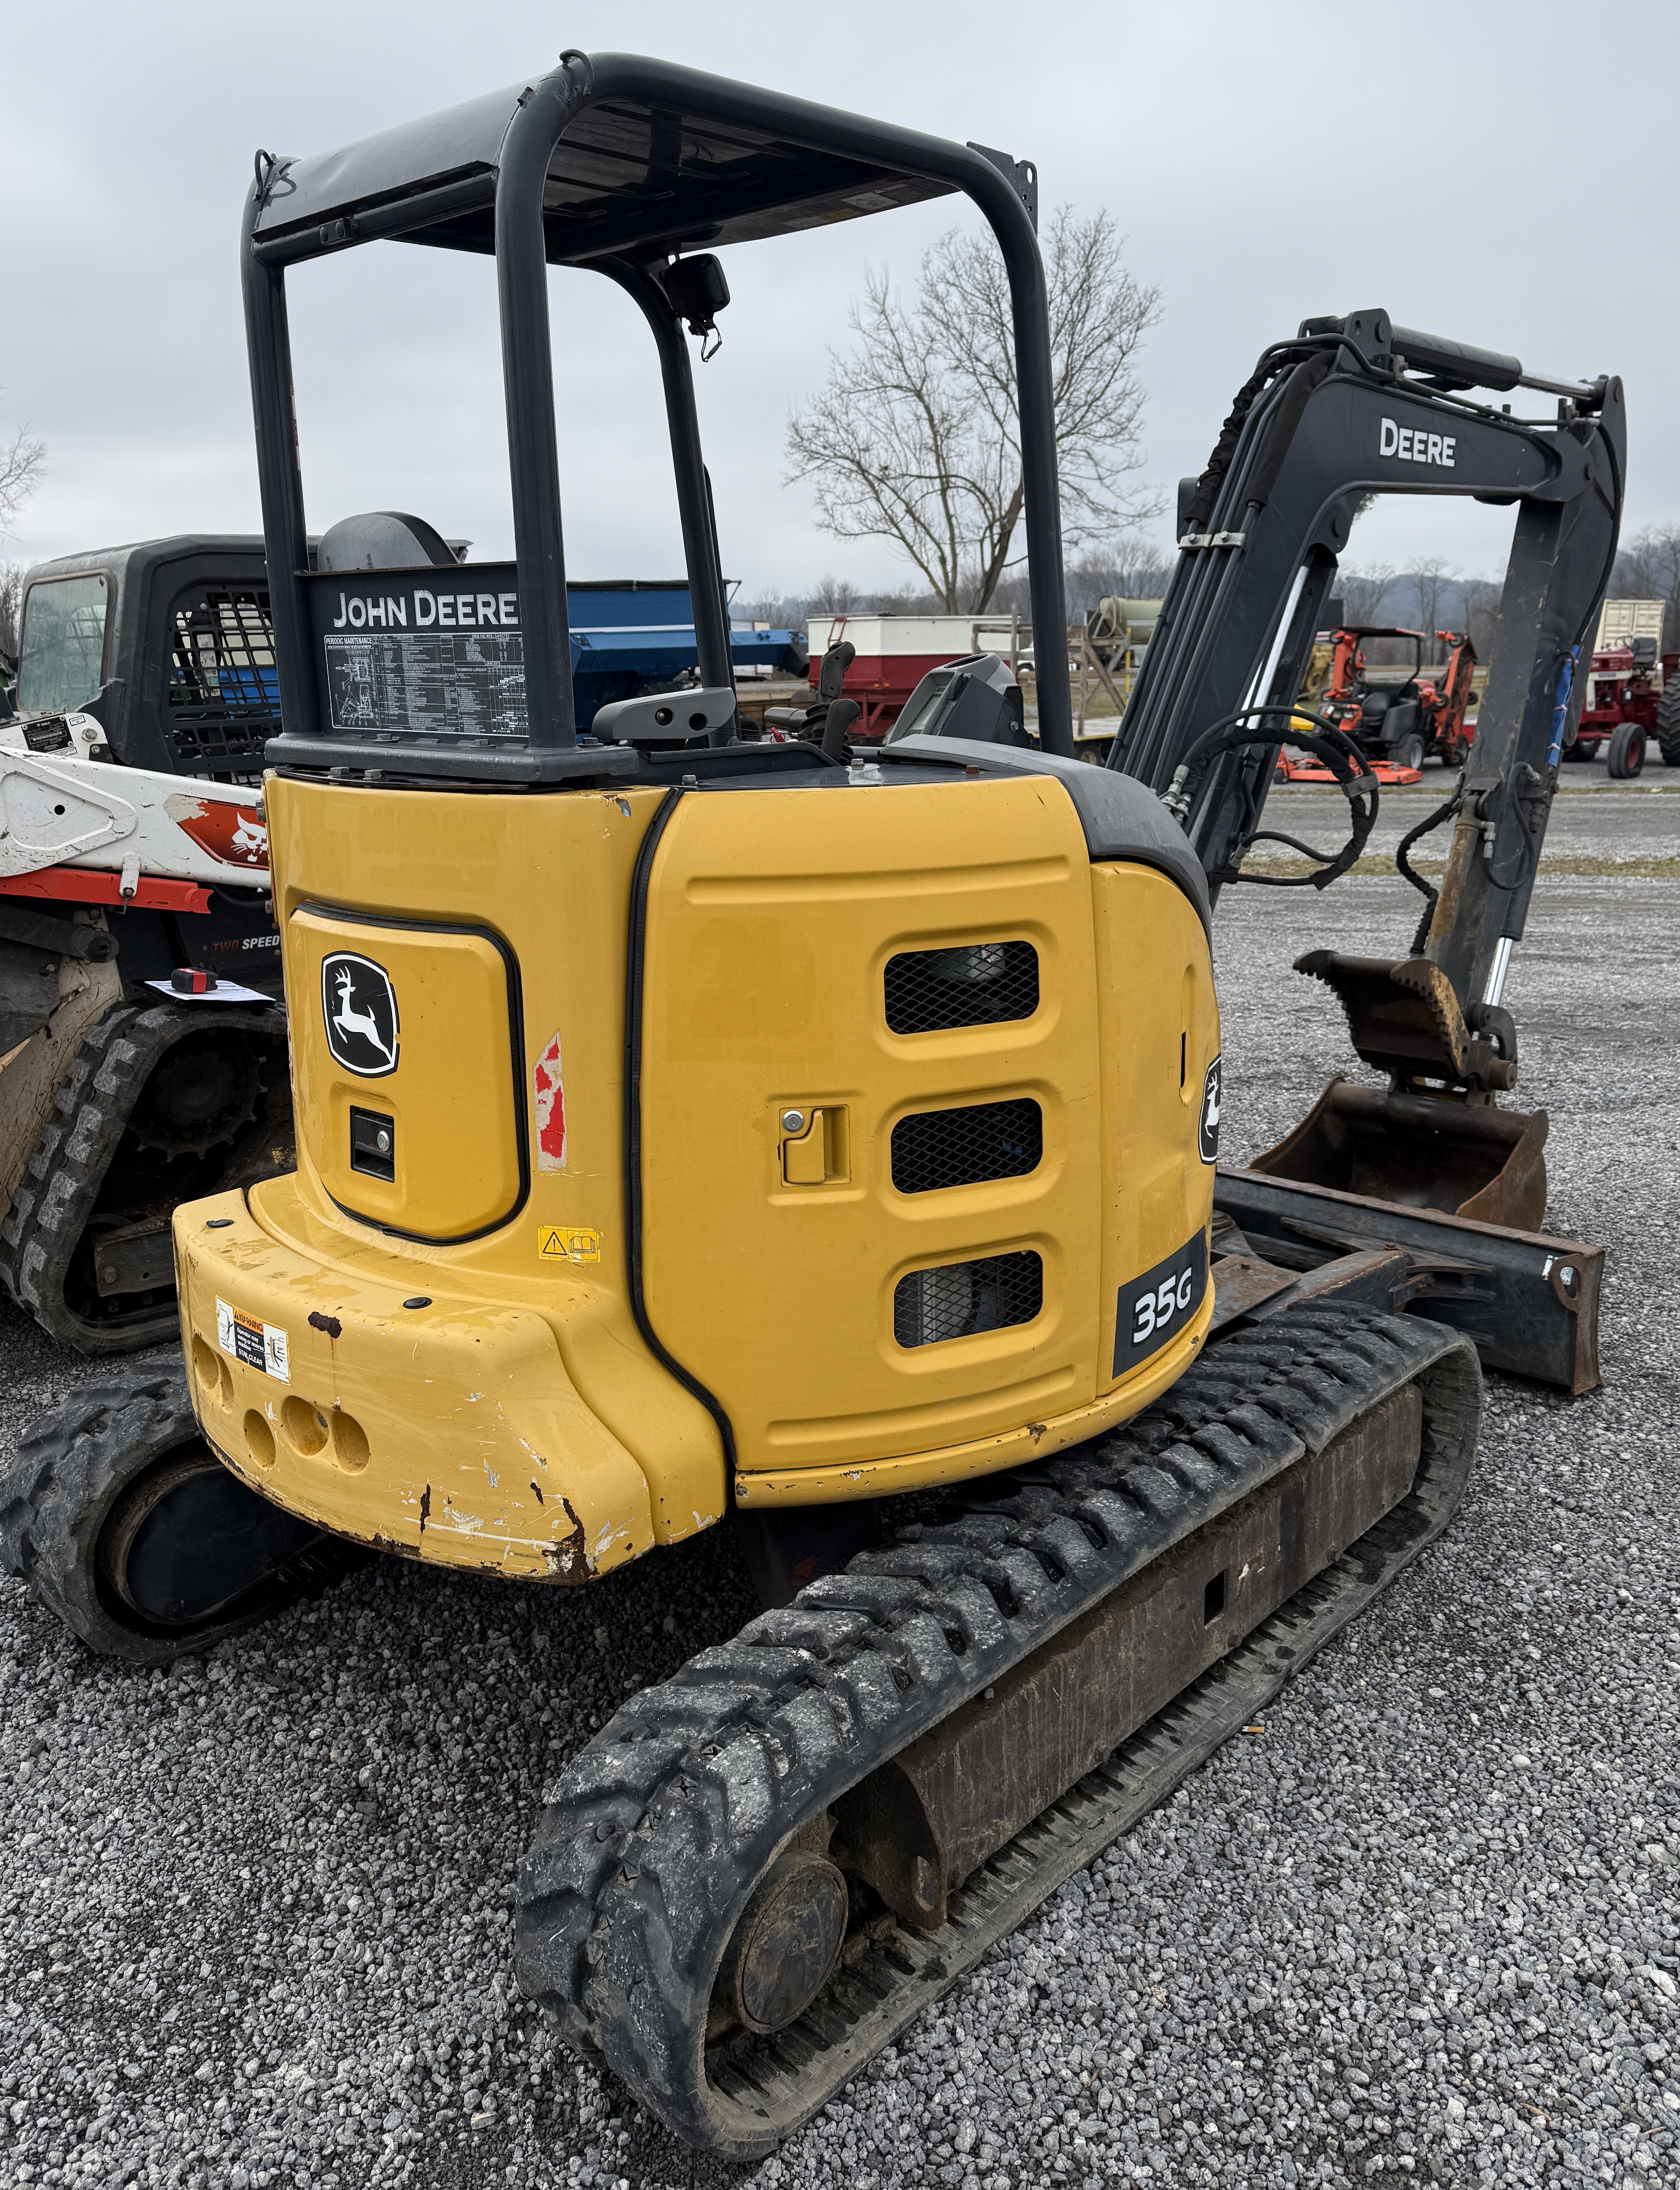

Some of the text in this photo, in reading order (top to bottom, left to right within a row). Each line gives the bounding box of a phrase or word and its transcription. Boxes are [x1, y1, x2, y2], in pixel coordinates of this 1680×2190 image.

[1380, 417, 1456, 467] DEERE
[333, 590, 519, 628] JOHN DEERE
[213, 935, 280, 953] TWO SPEED
[1133, 1267, 1192, 1343] 35G
[238, 1312, 263, 1331] WARNING
[249, 1354, 263, 1366] CLEAR
